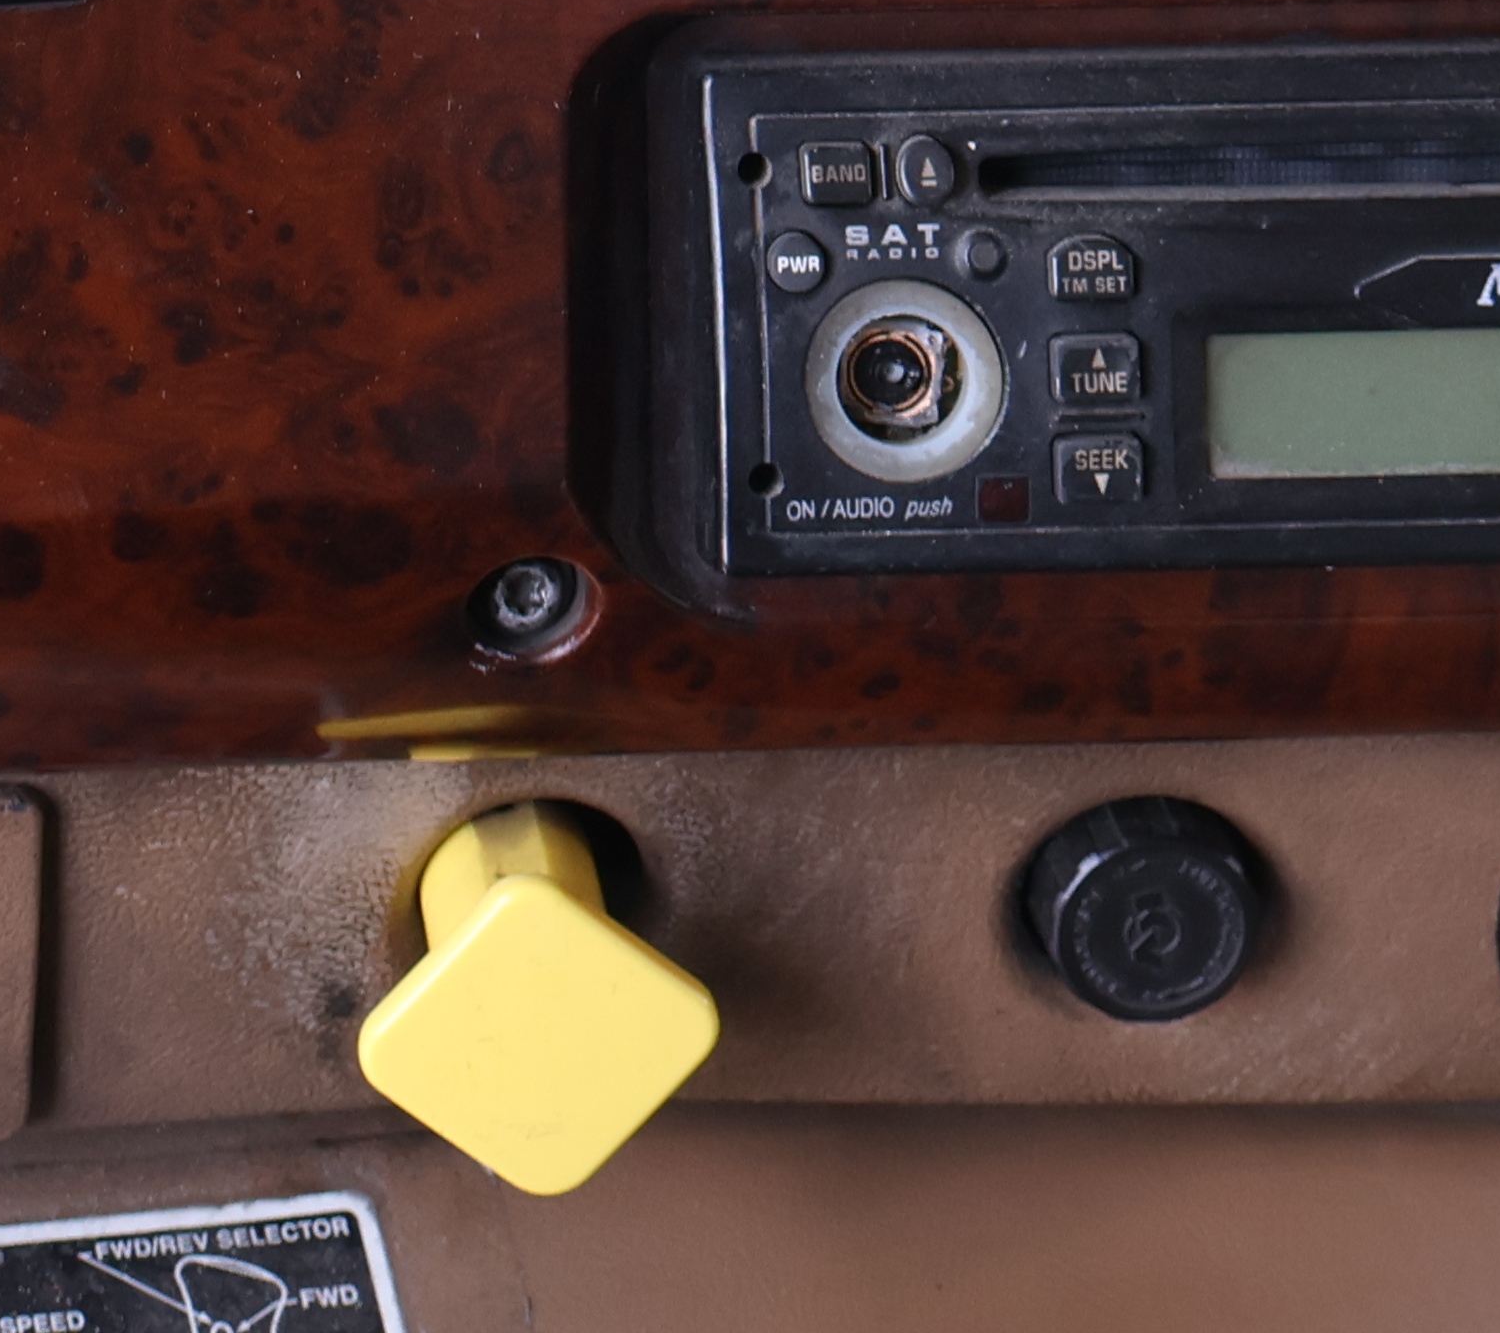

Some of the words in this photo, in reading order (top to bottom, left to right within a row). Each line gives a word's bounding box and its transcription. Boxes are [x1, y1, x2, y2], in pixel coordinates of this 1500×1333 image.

[811, 162, 866, 185] BAND
[844, 222, 941, 247] SAT
[776, 254, 820, 275] PWR
[845, 247, 941, 261] RADIO
[1066, 249, 1125, 274] DSPL
[1061, 277, 1089, 294] TM
[1094, 275, 1128, 293] SET
[1071, 371, 1129, 395] TUNE
[1074, 448, 1131, 471] SEEK
[904, 495, 954, 518] push
[93, 1231, 210, 1262] FWD/REV
[215, 1214, 350, 1251] SELECTOR
[298, 1283, 360, 1311] FWD
